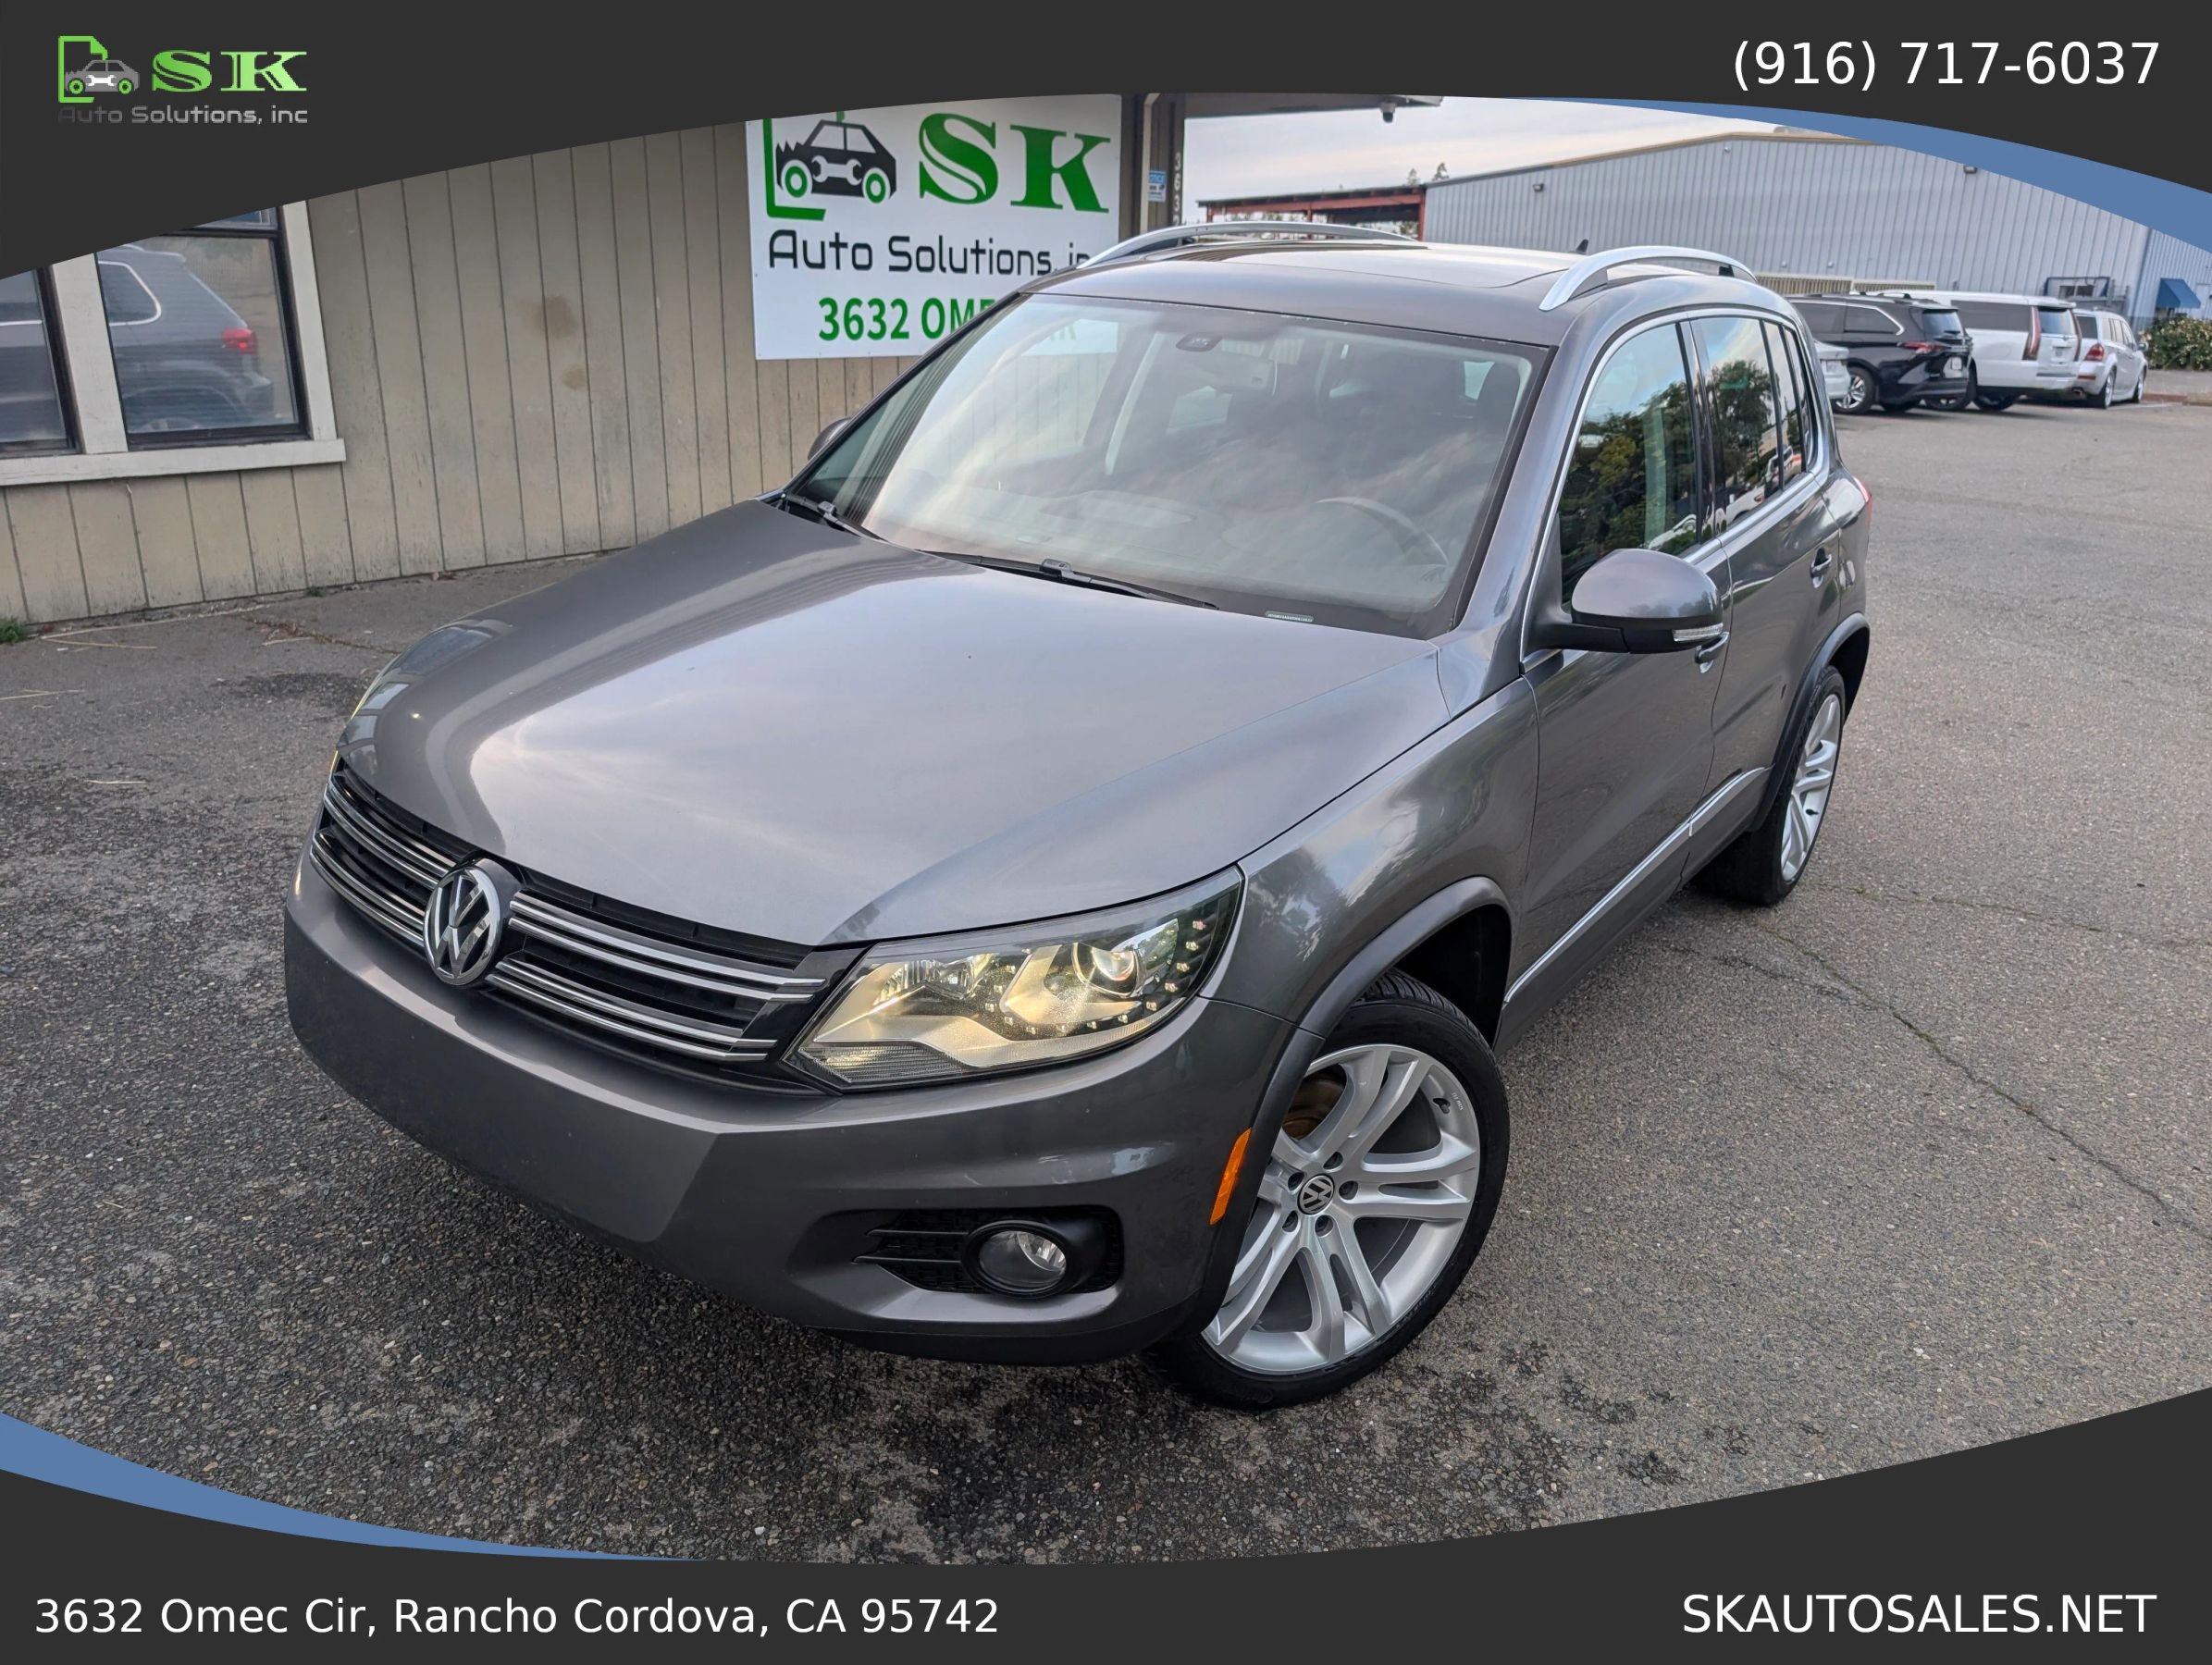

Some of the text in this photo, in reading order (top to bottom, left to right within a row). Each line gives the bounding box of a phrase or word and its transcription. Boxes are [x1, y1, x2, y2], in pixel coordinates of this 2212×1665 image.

[918, 112, 1111, 214] SK
[769, 229, 873, 271] Auto
[888, 234, 1057, 276] Solutions
[818, 296, 996, 341] 3632 OM
